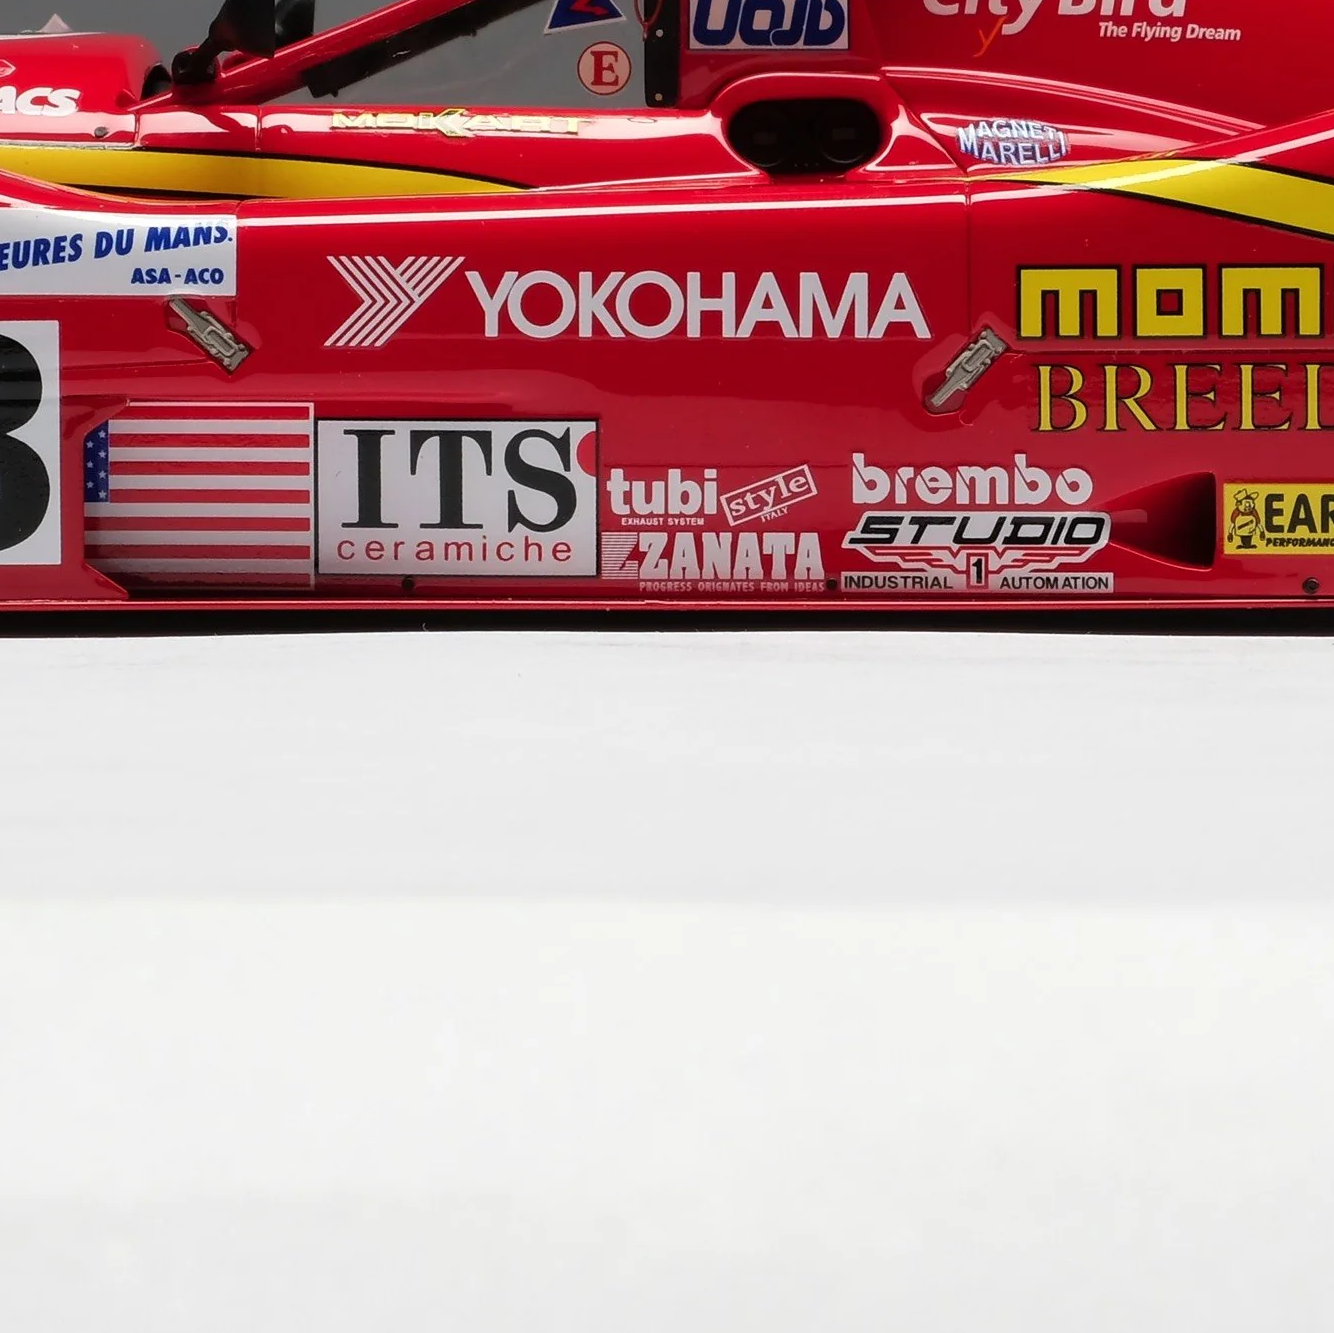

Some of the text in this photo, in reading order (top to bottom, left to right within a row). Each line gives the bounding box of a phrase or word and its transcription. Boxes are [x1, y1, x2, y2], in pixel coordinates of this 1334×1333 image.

[1098, 21, 1241, 42] The Flying Dream
[590, 50, 620, 86] E
[94, 227, 135, 259] DU
[465, 270, 932, 339] YOKOHAMA
[341, 427, 577, 533] ITS
[606, 468, 718, 515] tubi
[851, 452, 1094, 505] brembo
[729, 472, 809, 516] style
[621, 517, 705, 526] EXHAUST SYSTEM
[761, 505, 788, 523] ITALY
[848, 515, 1107, 545] STUDIO
[337, 535, 572, 562] ceramiche
[639, 532, 825, 580] ZANATA
[844, 575, 954, 589] INDUSTRIAL
[971, 557, 983, 584] 1
[999, 576, 1110, 590] AUTOMATION
[639, 581, 693, 592] PROGRESS
[760, 581, 789, 592] FROM
[794, 581, 825, 592] IDEAS
